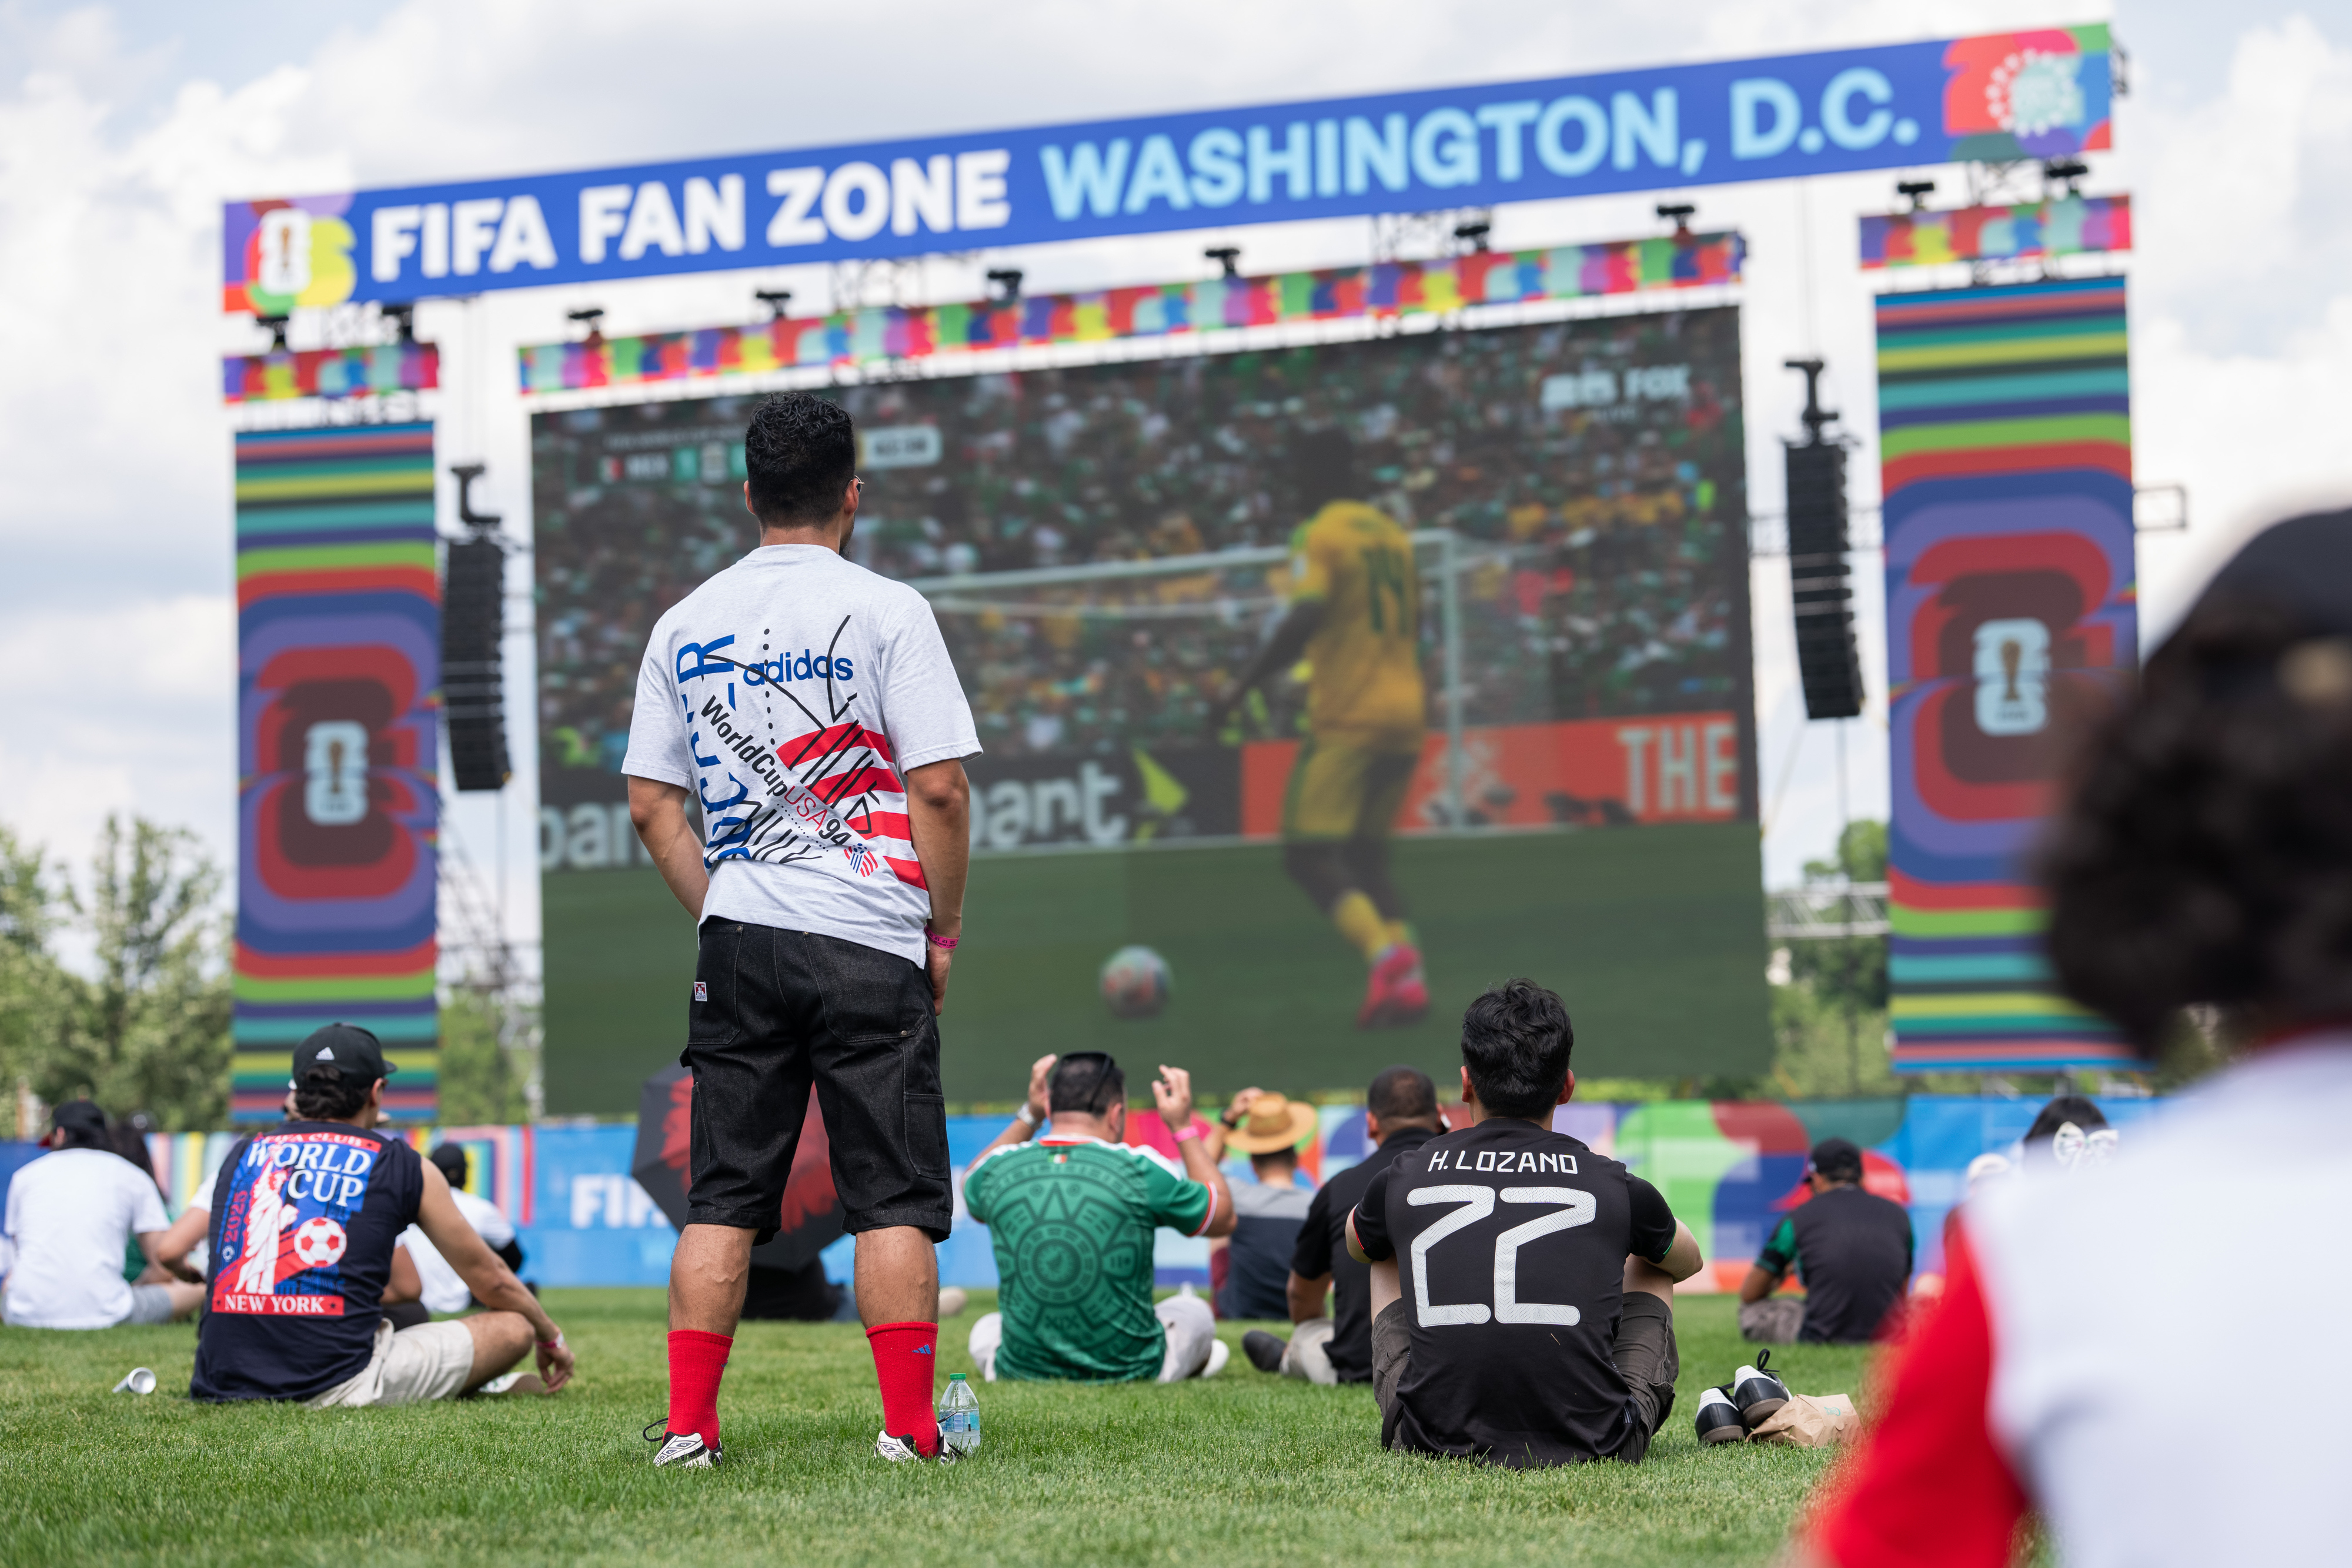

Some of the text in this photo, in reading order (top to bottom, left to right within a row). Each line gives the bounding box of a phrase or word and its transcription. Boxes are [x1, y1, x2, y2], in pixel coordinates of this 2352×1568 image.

[372, 66, 1920, 282] FIFA FAN ZONE WASHINGTON, D.C.
[743, 649, 853, 686] adidas
[1618, 722, 1738, 814] THE
[247, 1141, 371, 1175] WORLD
[308, 1133, 362, 1147] CLUB
[1428, 1150, 1578, 1174] H. LOZANO
[288, 1169, 364, 1207] CUP
[570, 1175, 669, 1228] FIF
[224, 1190, 248, 1242] 2025
[1407, 1185, 1596, 1328] 22
[225, 1294, 325, 1313] NEW YORK
